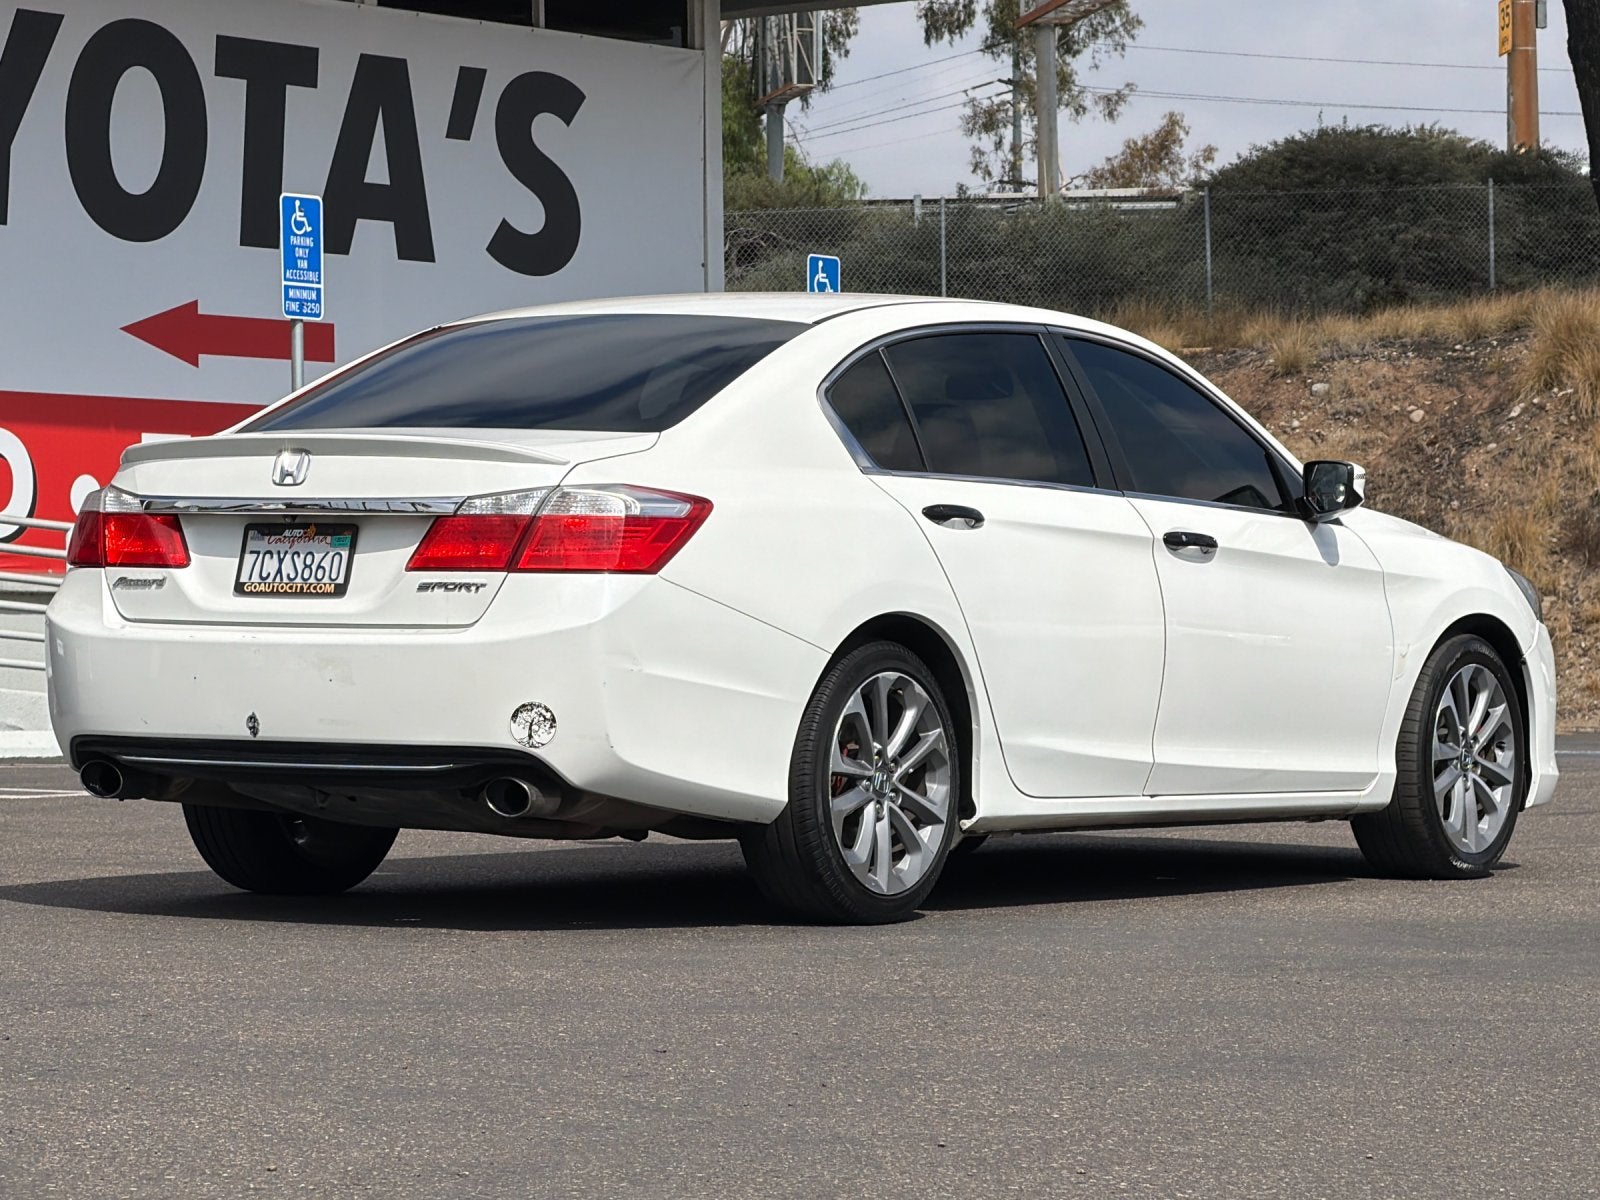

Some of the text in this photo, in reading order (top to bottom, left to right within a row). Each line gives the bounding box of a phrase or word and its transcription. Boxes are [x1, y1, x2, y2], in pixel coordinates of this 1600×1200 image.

[1500, 4, 1511, 31] 35
[290, 236, 314, 247] PARKING
[295, 247, 309, 258] ONLY
[297, 259, 308, 269] VAN
[286, 269, 319, 282] ACCESSIBLE
[288, 288, 317, 300] MINIMUM
[285, 301, 320, 314] FINE $250
[248, 549, 343, 582] 7CXS860
[243, 582, 335, 593] GOAUTOCITY.COM
[416, 582, 487, 594] SPORT
